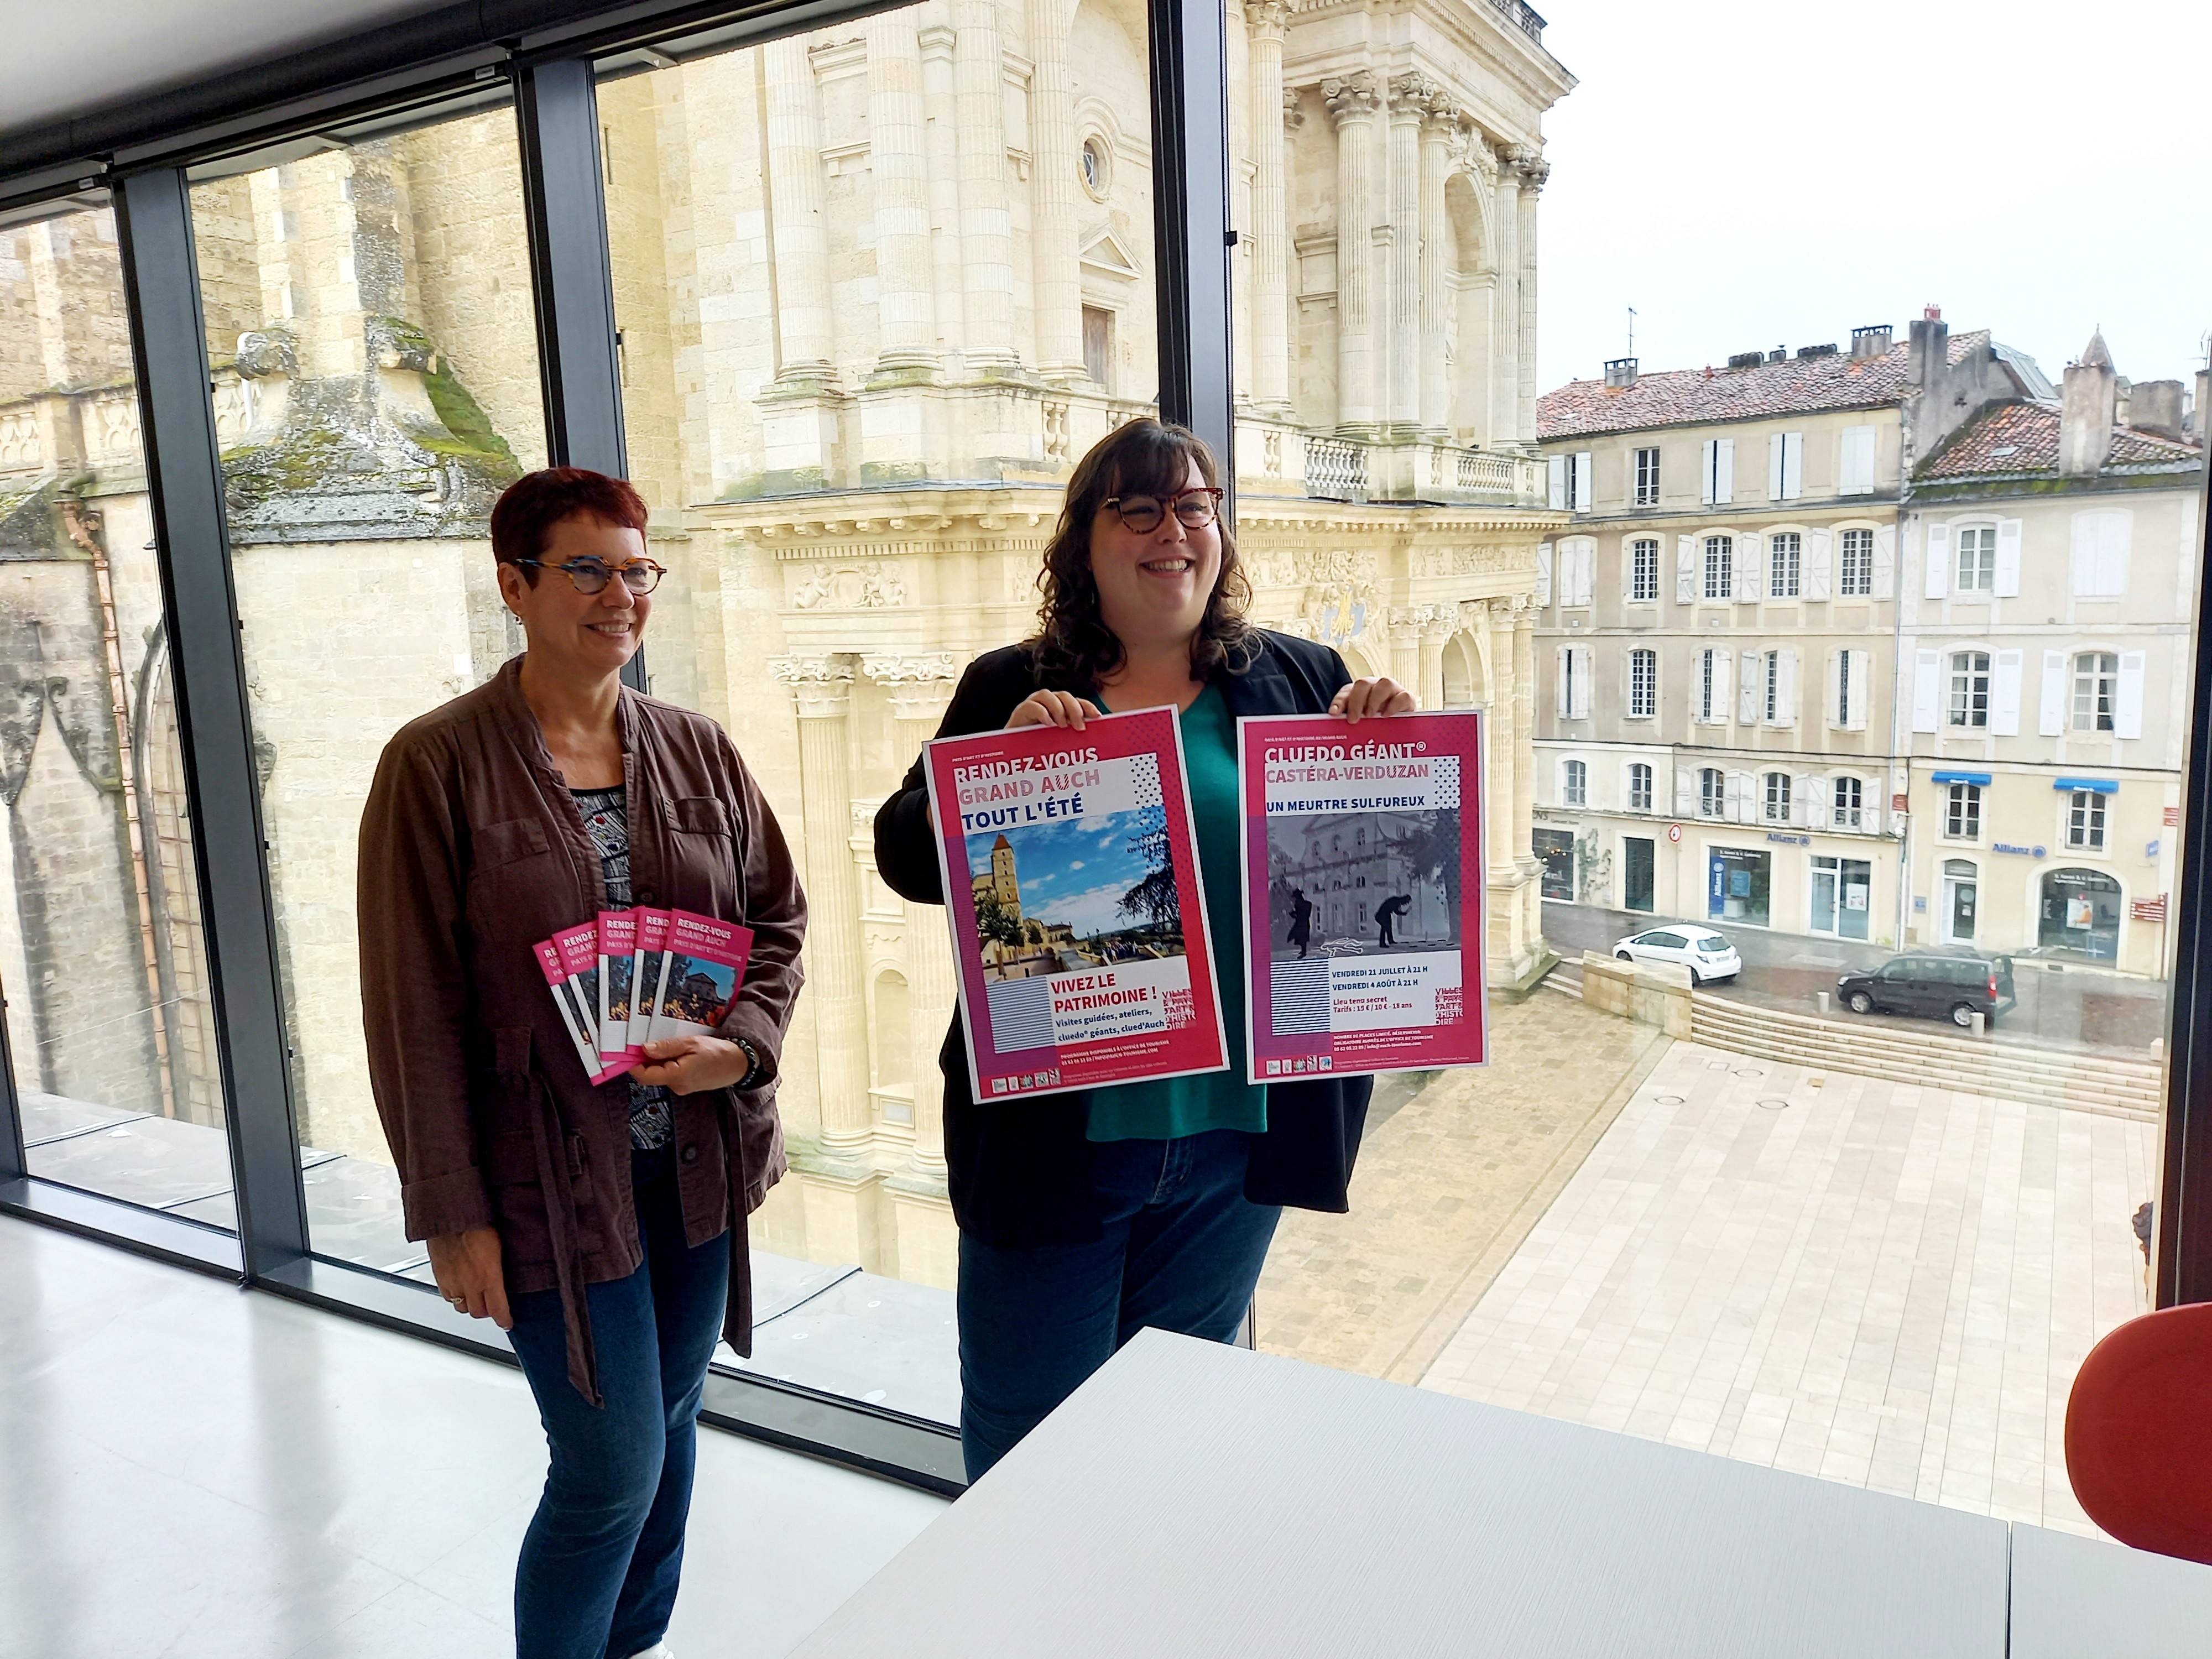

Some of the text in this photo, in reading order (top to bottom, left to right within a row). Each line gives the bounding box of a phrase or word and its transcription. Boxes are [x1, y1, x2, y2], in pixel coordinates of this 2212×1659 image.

[1265, 745, 1345, 764] CLUEDO
[953, 747, 1098, 783] RENDEZ-VOUS
[1266, 764, 1428, 783] CASTÉRA-VERDUZAN
[959, 769, 1100, 805] GRAND AUCH
[962, 792, 1083, 830] TOUT L'ÉTÉ
[1266, 796, 1425, 812] UN MEURTRE SULFUREUX
[1766, 833, 1797, 844] Allianz
[1992, 843, 2030, 855] Allianz
[1714, 873, 1723, 897] Allianz
[676, 928, 728, 947] GRAND AUCH
[677, 917, 732, 940] RENDEZ-VOUS
[1407, 965, 1412, 973] À
[1051, 973, 1116, 994] VIVEZ LE
[1376, 979, 1396, 988] AOÛT
[1054, 986, 1157, 1013] PATRIMOINE !
[1055, 1008, 1152, 1027] Visites guidées, ateliers,
[1090, 1027, 1120, 1039] géants,
[1121, 1020, 1165, 1032] clued'Auch
